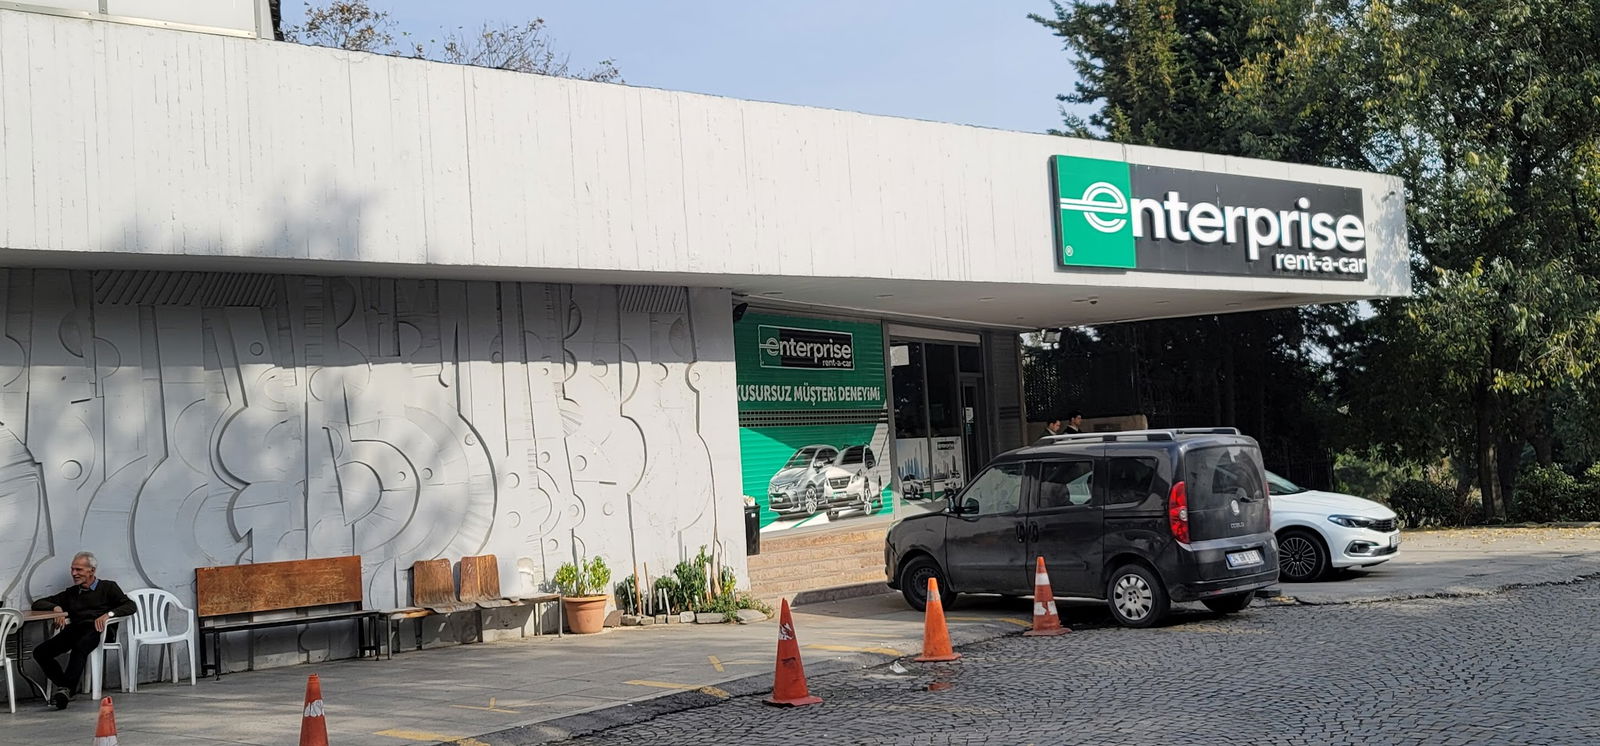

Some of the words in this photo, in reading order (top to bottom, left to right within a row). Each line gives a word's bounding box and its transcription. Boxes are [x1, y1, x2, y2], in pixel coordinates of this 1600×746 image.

[1060, 181, 1365, 260] enterprise
[1275, 251, 1366, 274] rent-a-car
[759, 337, 852, 363] enterprise
[822, 358, 852, 367] rent-a-car
